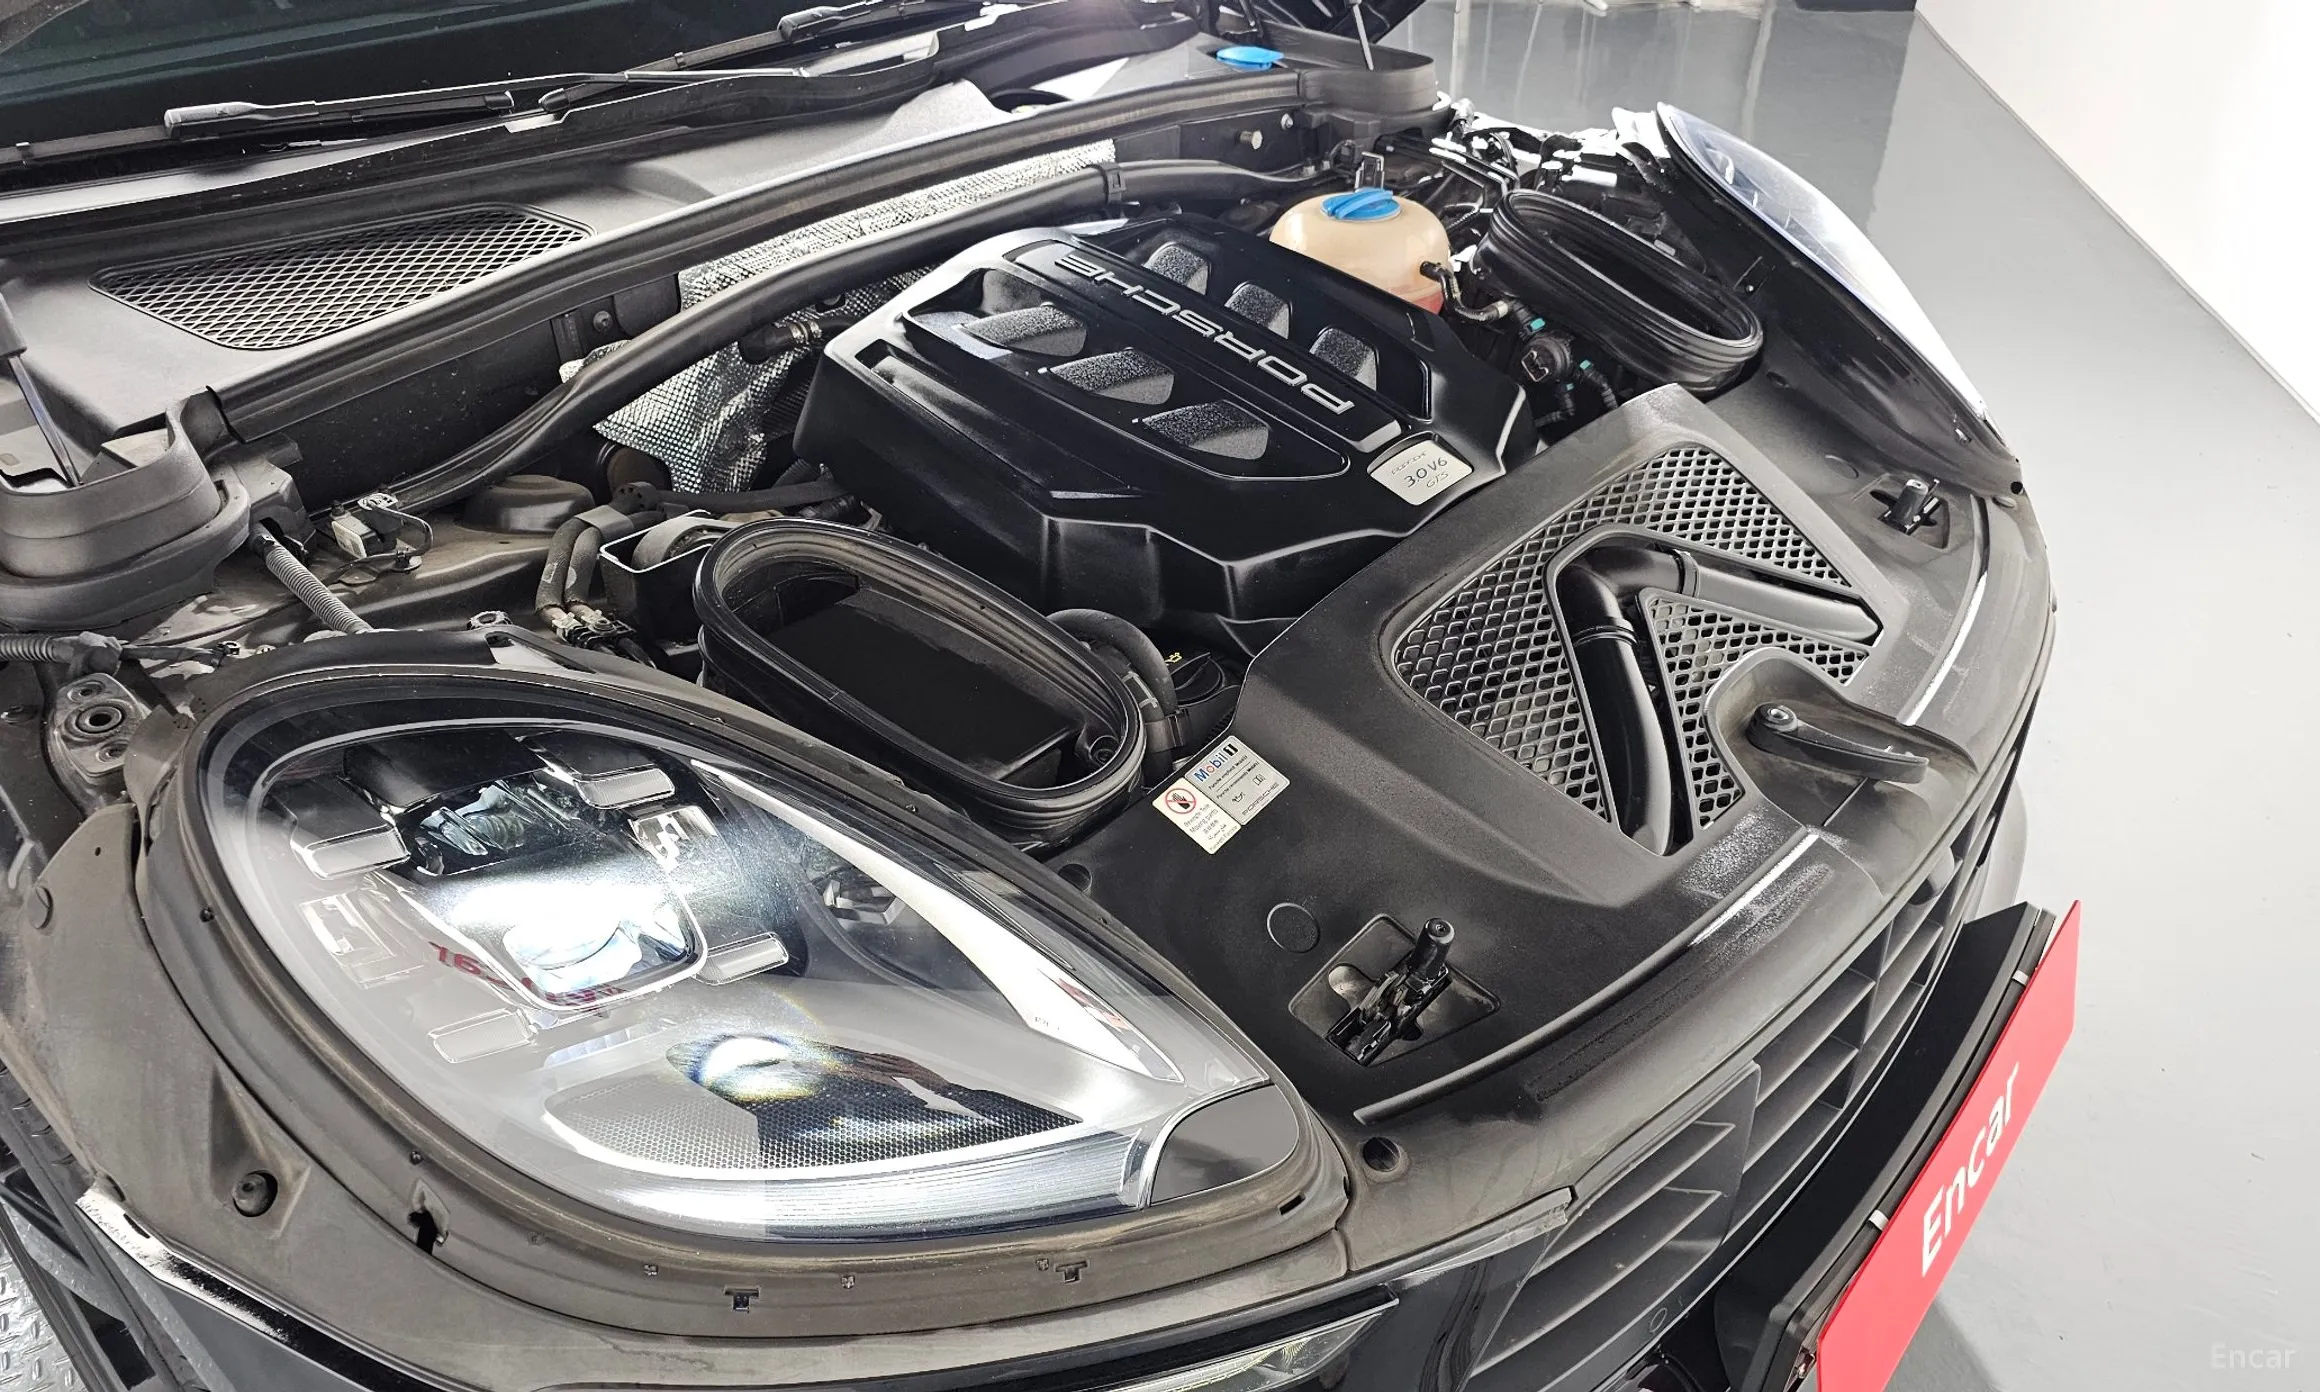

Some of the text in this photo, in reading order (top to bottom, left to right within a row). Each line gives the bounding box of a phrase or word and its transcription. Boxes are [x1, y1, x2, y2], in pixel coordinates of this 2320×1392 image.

[1054, 254, 1355, 415] PORSCHE
[1404, 467, 1428, 488] 3.0
[1427, 457, 1448, 471] V6
[1426, 471, 1449, 488] GTS
[1193, 752, 1229, 782] Mobil
[1223, 743, 1239, 757] 1
[1242, 782, 1279, 815] PORSCHE
[1922, 1061, 2020, 1279] Encar
